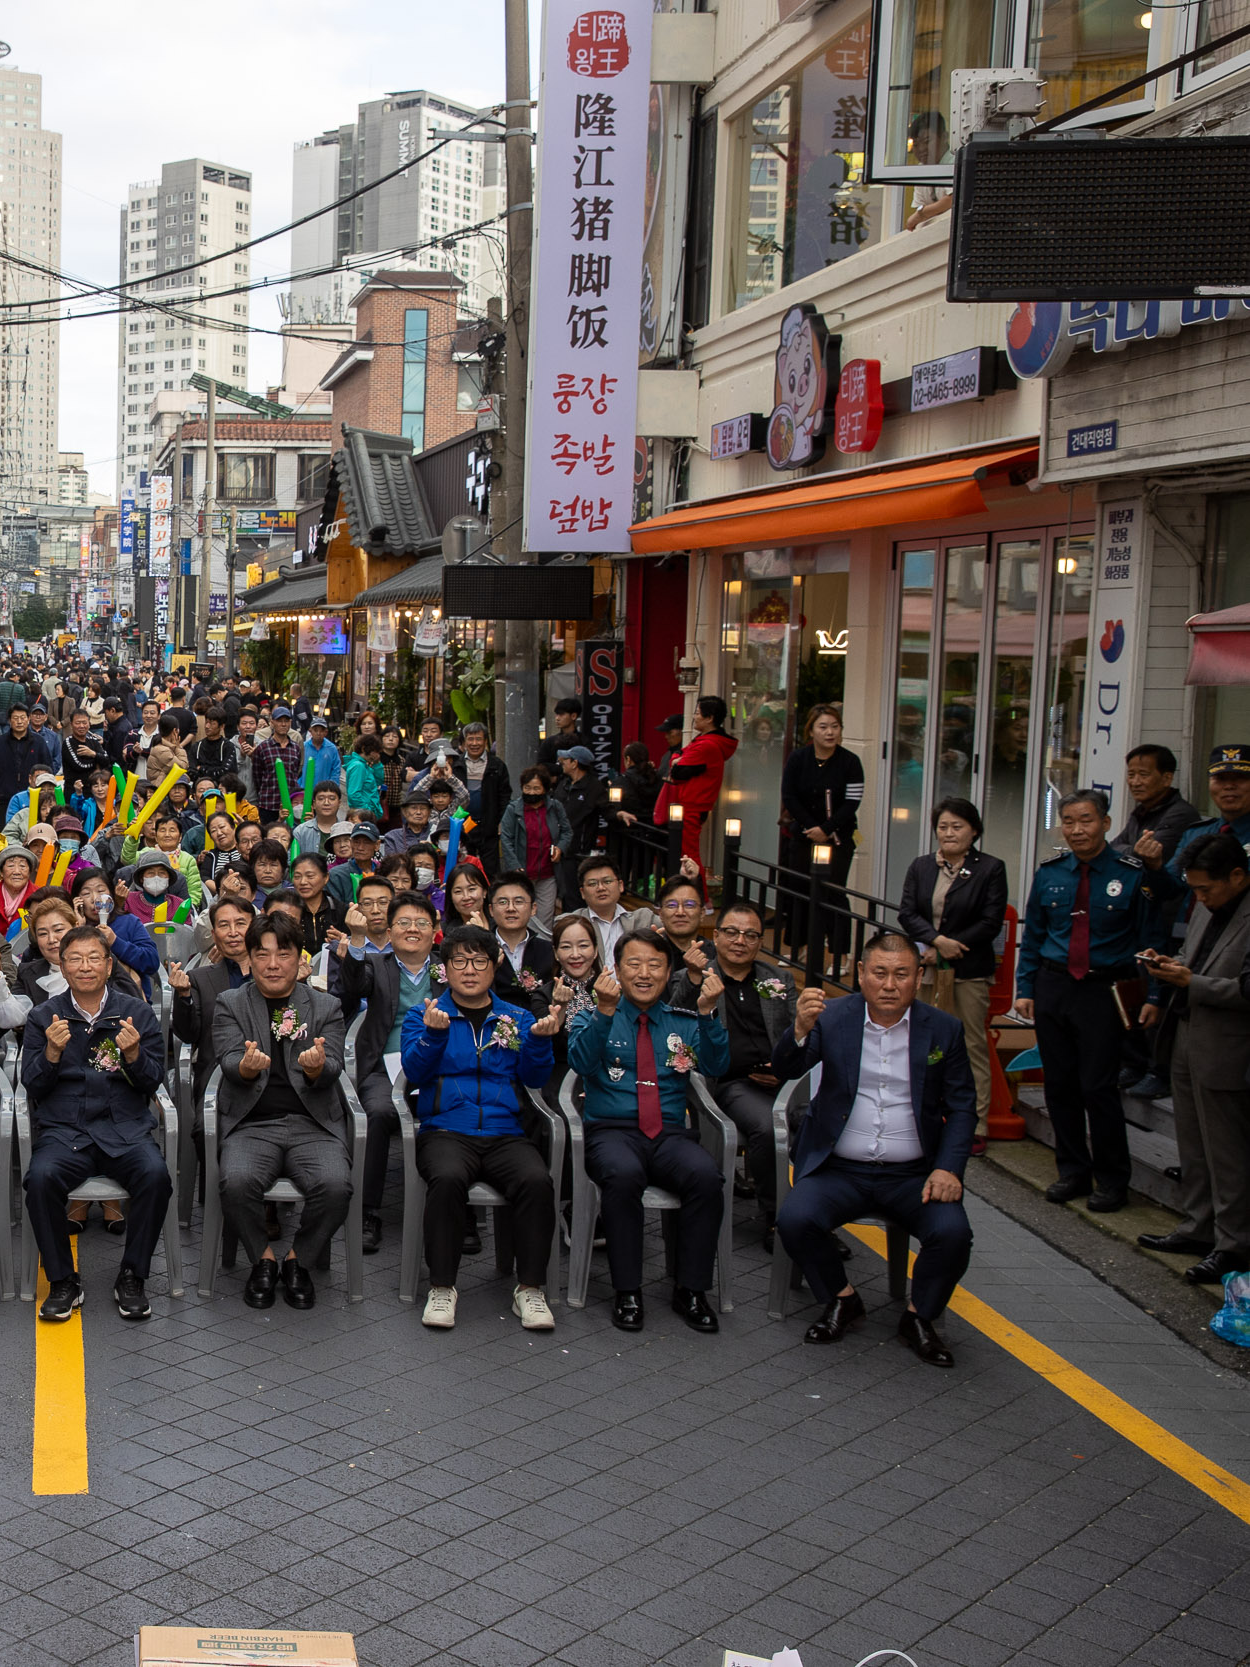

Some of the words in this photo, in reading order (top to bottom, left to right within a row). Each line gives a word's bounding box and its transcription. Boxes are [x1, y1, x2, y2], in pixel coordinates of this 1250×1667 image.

[567, 92, 618, 351] 隆江猪脚饭
[914, 362, 946, 385] 예약문의
[914, 373, 976, 407] 02-6465-8999
[1070, 426, 1114, 451] 건대직영점
[551, 433, 616, 477] 족발
[549, 494, 613, 534] 덮밥
[1108, 508, 1134, 525] 피부과
[1110, 527, 1130, 544] 전용
[1105, 546, 1132, 562] 기능성
[1103, 565, 1131, 580] 화장품
[589, 648, 618, 696] S
